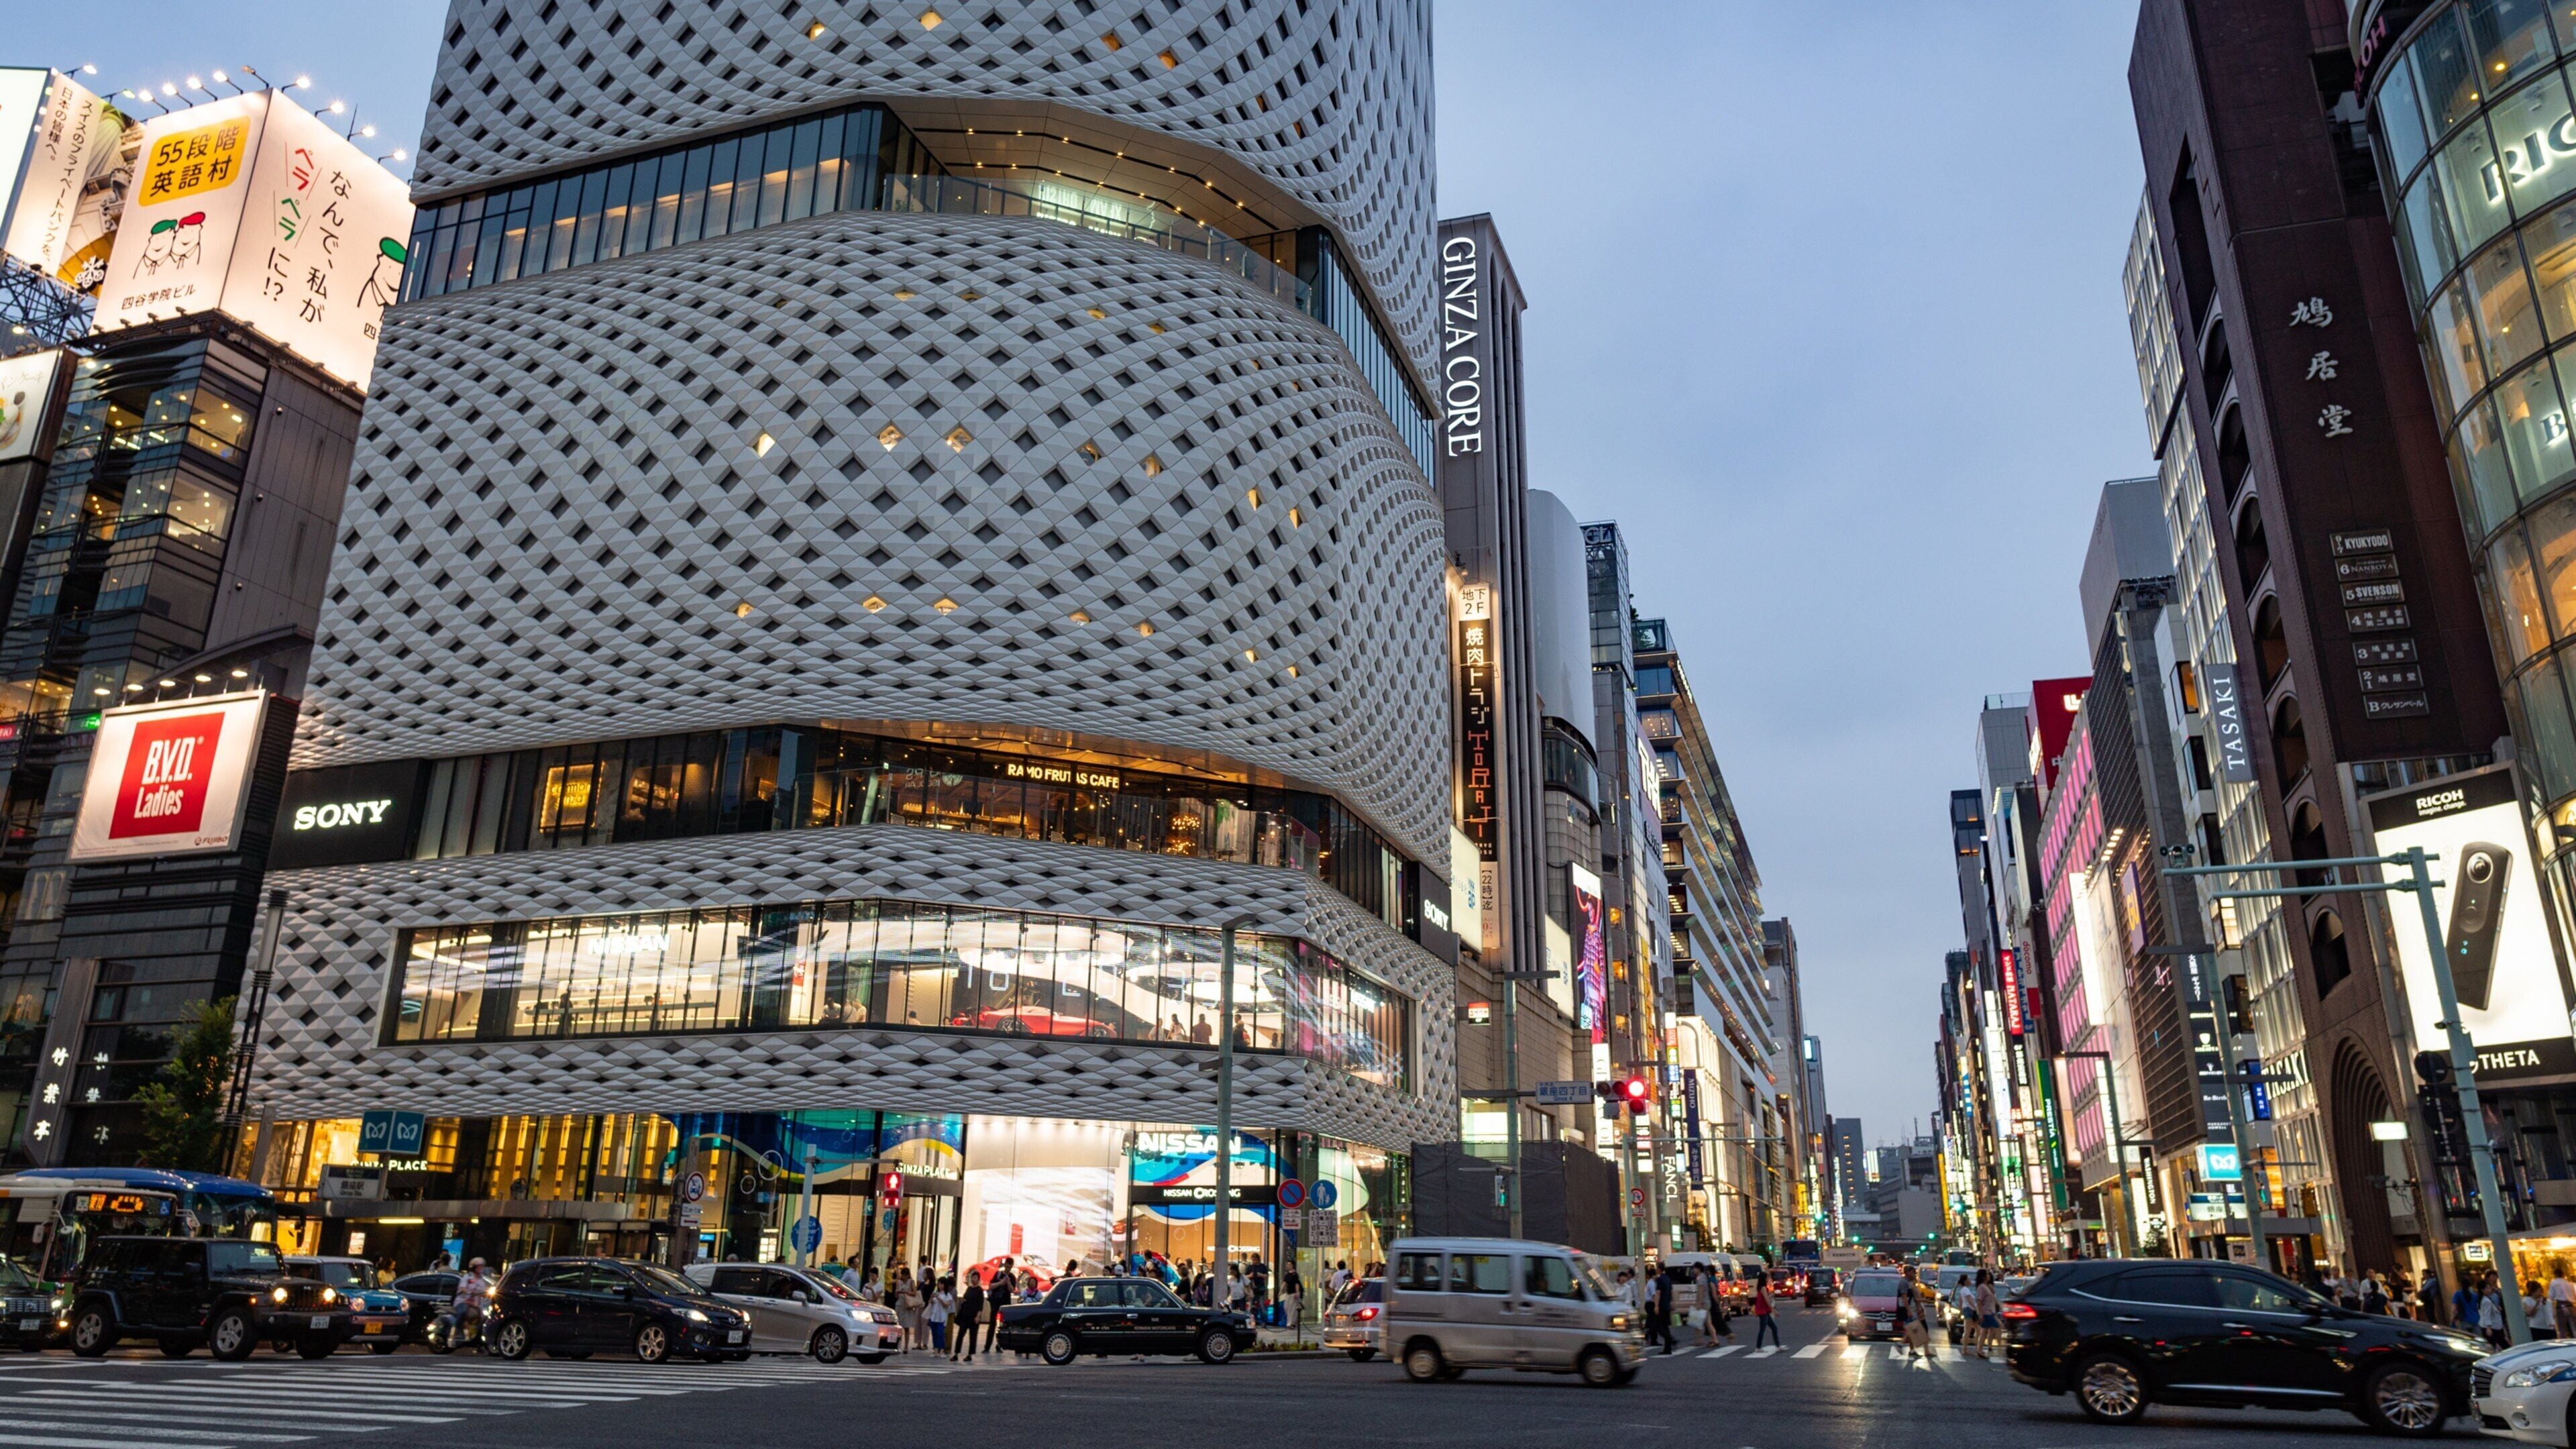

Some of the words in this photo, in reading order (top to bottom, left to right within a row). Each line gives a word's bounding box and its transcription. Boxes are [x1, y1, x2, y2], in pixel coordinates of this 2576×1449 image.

[156, 125, 239, 167] 55段階
[150, 155, 232, 197] 英語村
[300, 170, 352, 323] なんで、私が
[121, 283, 196, 310] 四谷学院ビル
[1443, 236, 1478, 352] GINZA
[1446, 356, 1482, 457] CORE
[2345, 535, 2388, 549] KYUKYODO
[2340, 564, 2350, 574] 6
[1461, 588, 1486, 601] 地下
[2347, 590, 2355, 600] 5
[2355, 584, 2400, 598] SVENSON
[2352, 616, 2361, 625] 4
[2357, 648, 2368, 659] 3
[1466, 627, 1490, 724] 焼肉トラジ
[2368, 701, 2380, 712] B
[2214, 676, 2245, 770] TASAKI
[142, 737, 197, 785] B.V.D.
[1008, 763, 1042, 779] RAMO
[1089, 775, 1119, 789] CAFE
[134, 784, 184, 818] Ladies
[2416, 788, 2463, 809] RICOH
[294, 800, 391, 830] SONY
[202, 836, 228, 845] FUJIBO
[1424, 900, 1448, 931] SONY
[2023, 941, 2033, 975] docomo
[2261, 1049, 2309, 1100] TASAKI
[2478, 1049, 2540, 1070] THETA
[1540, 1087, 1587, 1095] 銀座四丁目
[1688, 1078, 1696, 1108] MIZUHO
[2045, 1098, 2056, 1138] PRESTIA
[1138, 1132, 1241, 1155] NISSAN
[388, 1160, 427, 1171] PLACE
[1664, 1156, 1678, 1203] FANCL
[1163, 1189, 1192, 1197] NISSAN
[2143, 1157, 2156, 1205] WASHINGTON
